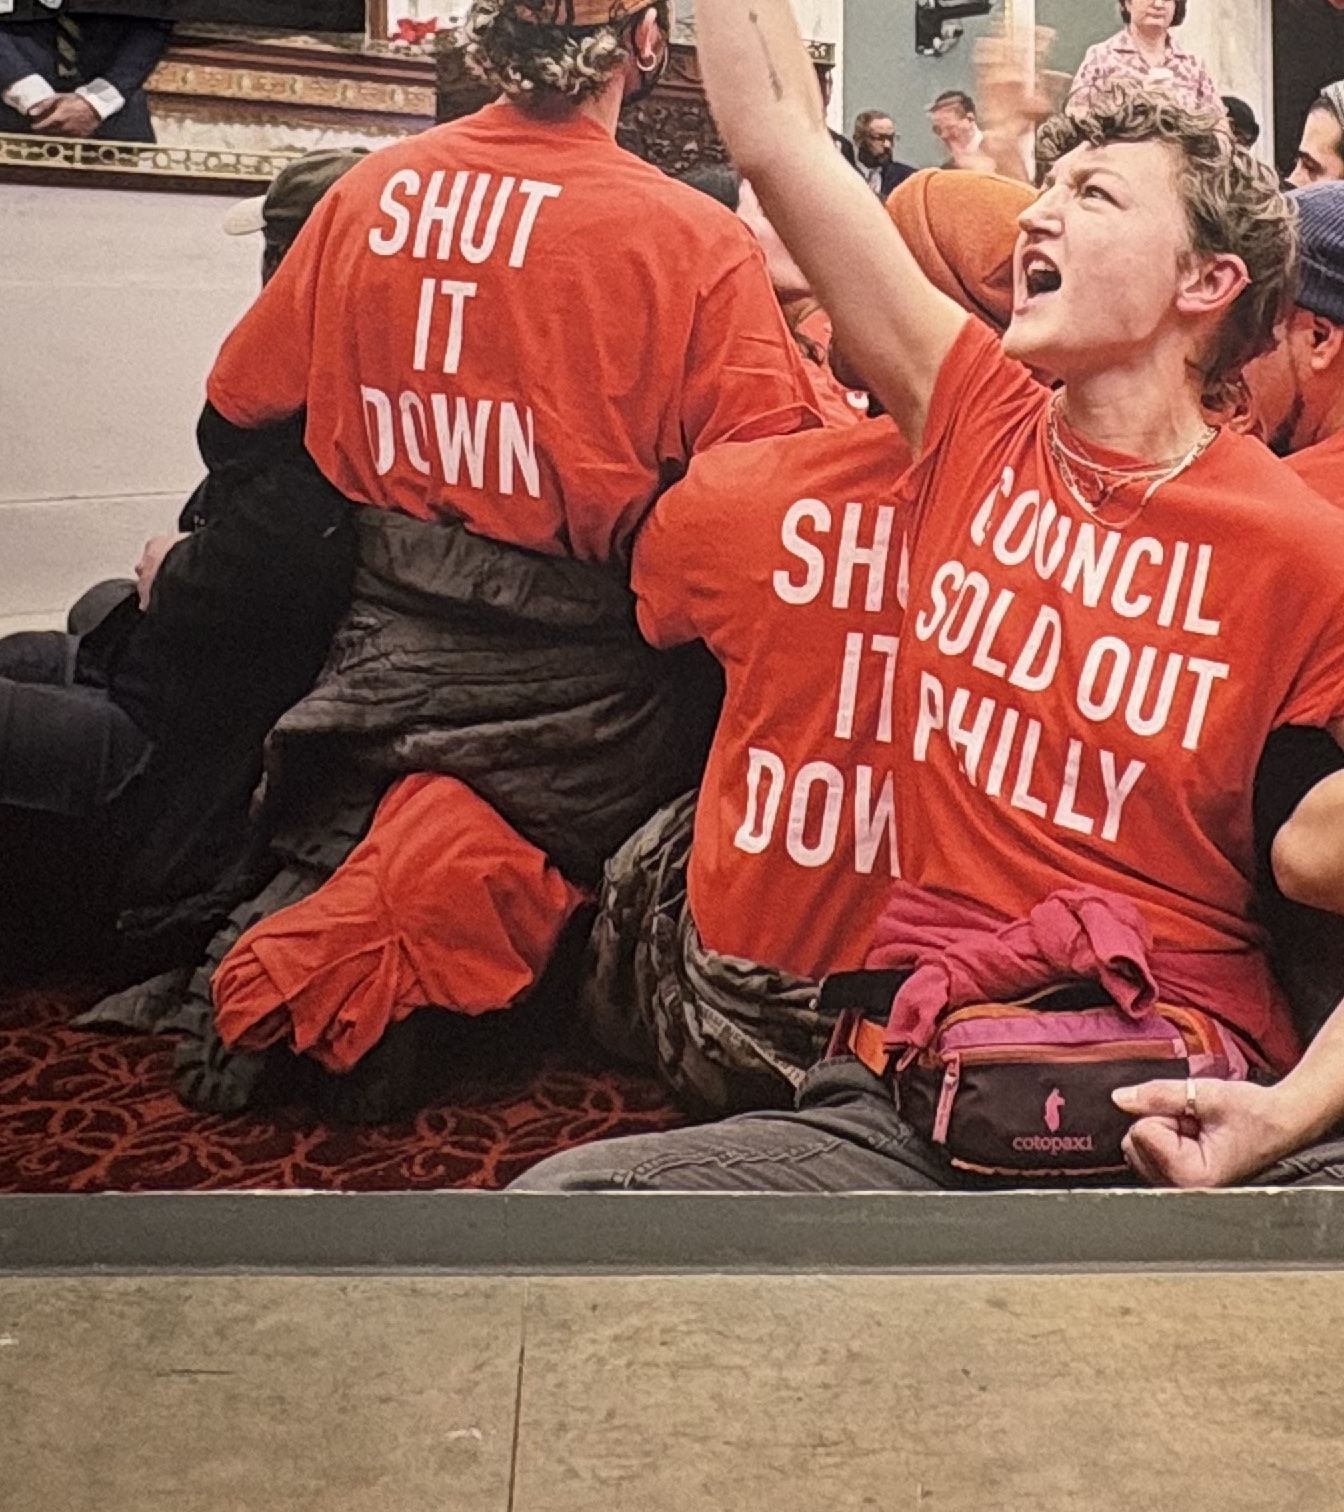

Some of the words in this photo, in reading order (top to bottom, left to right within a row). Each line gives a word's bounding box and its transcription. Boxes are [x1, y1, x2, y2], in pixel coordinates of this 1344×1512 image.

[368, 169, 561, 268] SHUT
[413, 278, 476, 374] IT
[360, 386, 542, 498] DOWN
[772, 497, 910, 612] SH
[915, 561, 1062, 693] SOLD
[1076, 636, 1229, 751] OUT
[913, 670, 1147, 843] PHILLY
[1012, 1135, 1093, 1155] cotopaxi
